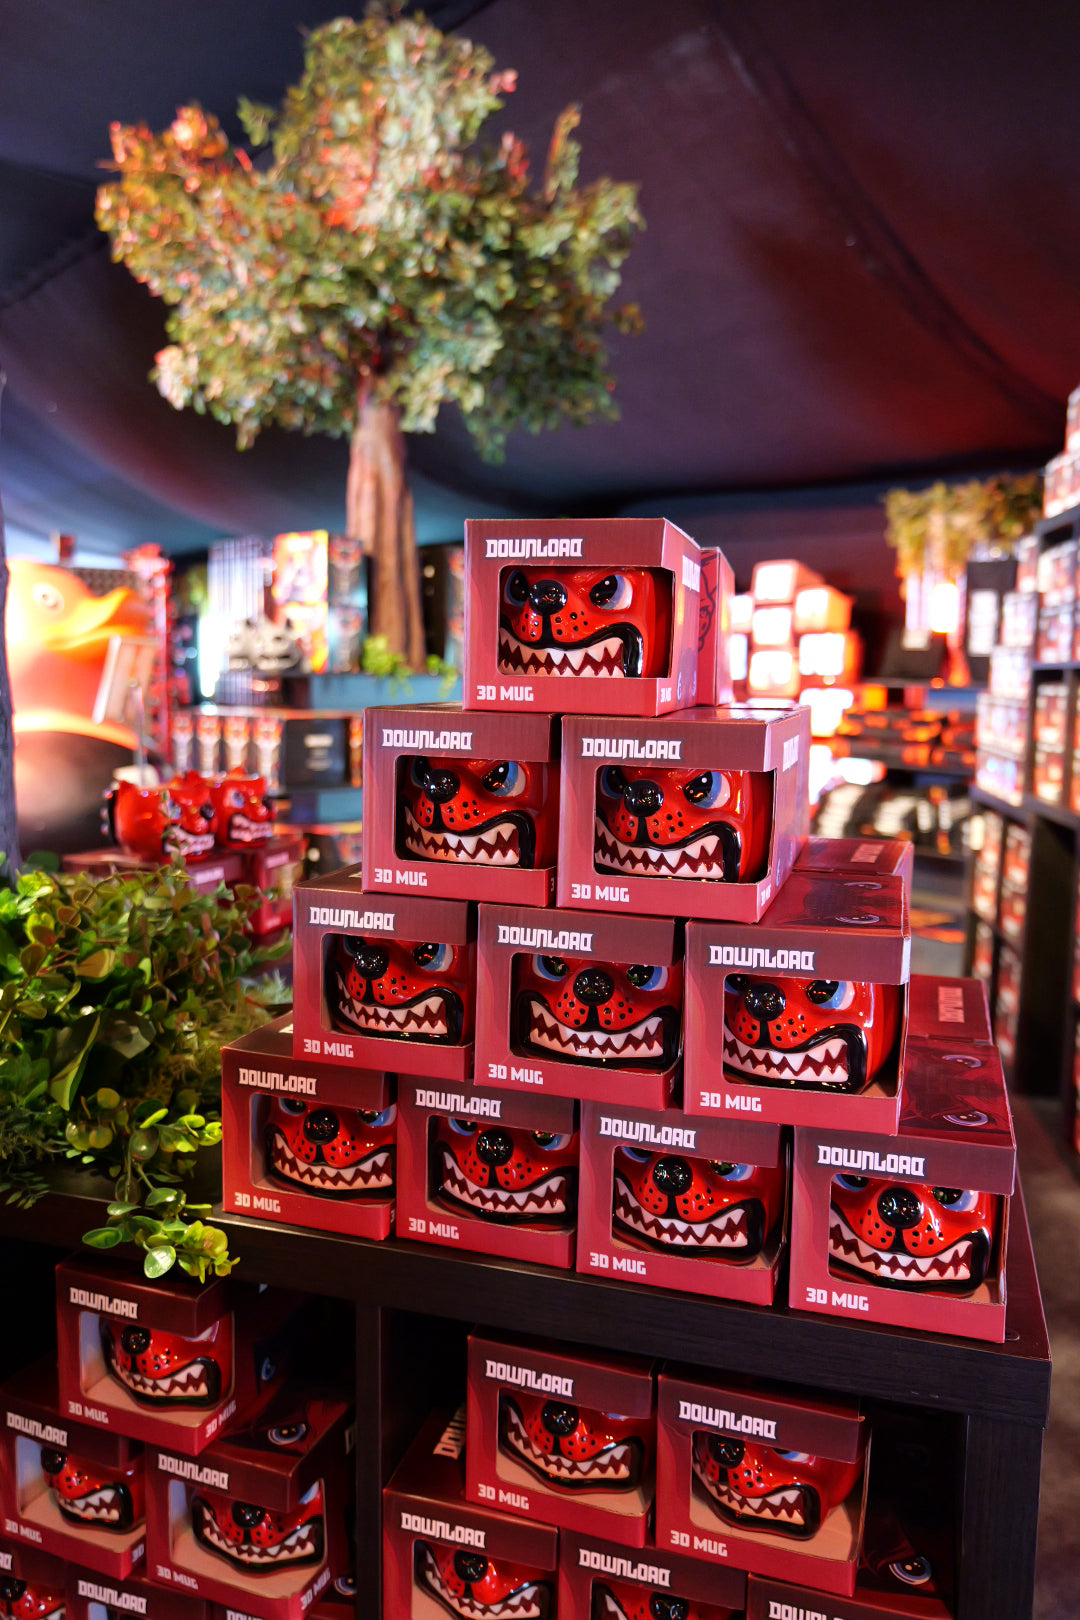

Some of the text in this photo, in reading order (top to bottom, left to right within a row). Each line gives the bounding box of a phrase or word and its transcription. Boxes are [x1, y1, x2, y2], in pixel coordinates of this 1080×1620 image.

[486, 539, 583, 558] DOWNLOAD
[477, 686, 533, 701] 3D MUG
[382, 729, 472, 750] DOWNLOAD
[582, 738, 681, 759] DOWNLOAD
[375, 868, 427, 886] 3D MUG
[572, 884, 629, 902] 3D MUG
[310, 907, 394, 930] DOWNLOAD
[498, 926, 593, 951] DOWNLOAD
[709, 946, 814, 970] DOWNLOAD
[304, 1039, 353, 1058] 3D MUG
[239, 1068, 316, 1094] DOWNLOAD
[489, 1064, 543, 1084] 3D MUG
[416, 1089, 501, 1117] DOWNLOAD
[700, 1092, 761, 1112] 3D MUG
[600, 1117, 696, 1148] DOWNLOAD
[818, 1146, 925, 1176] DOWNLOAD
[235, 1192, 280, 1213] 3D MUG
[409, 1218, 459, 1239] 3D MUG
[590, 1252, 646, 1274] 3D MUG
[70, 1287, 138, 1319] DOWNLOAD
[806, 1288, 869, 1311] 3D MUG
[486, 1360, 573, 1397] DOWNLOAD
[69, 1401, 109, 1424] 3D MUG
[679, 1401, 776, 1439] DOWNLOAD
[7, 1412, 67, 1447] DOWNLOAD
[158, 1453, 229, 1490] DOWNLOAD
[478, 1483, 529, 1510] 3D MUG
[6, 1519, 42, 1544] 3D MUG
[401, 1513, 485, 1548] DOWNLOAD
[671, 1530, 728, 1558] 3D MUG
[157, 1565, 198, 1590] 3D MUG
[579, 1549, 670, 1587] DOWNLOAD
[78, 1580, 147, 1614] DOWNLOAD
